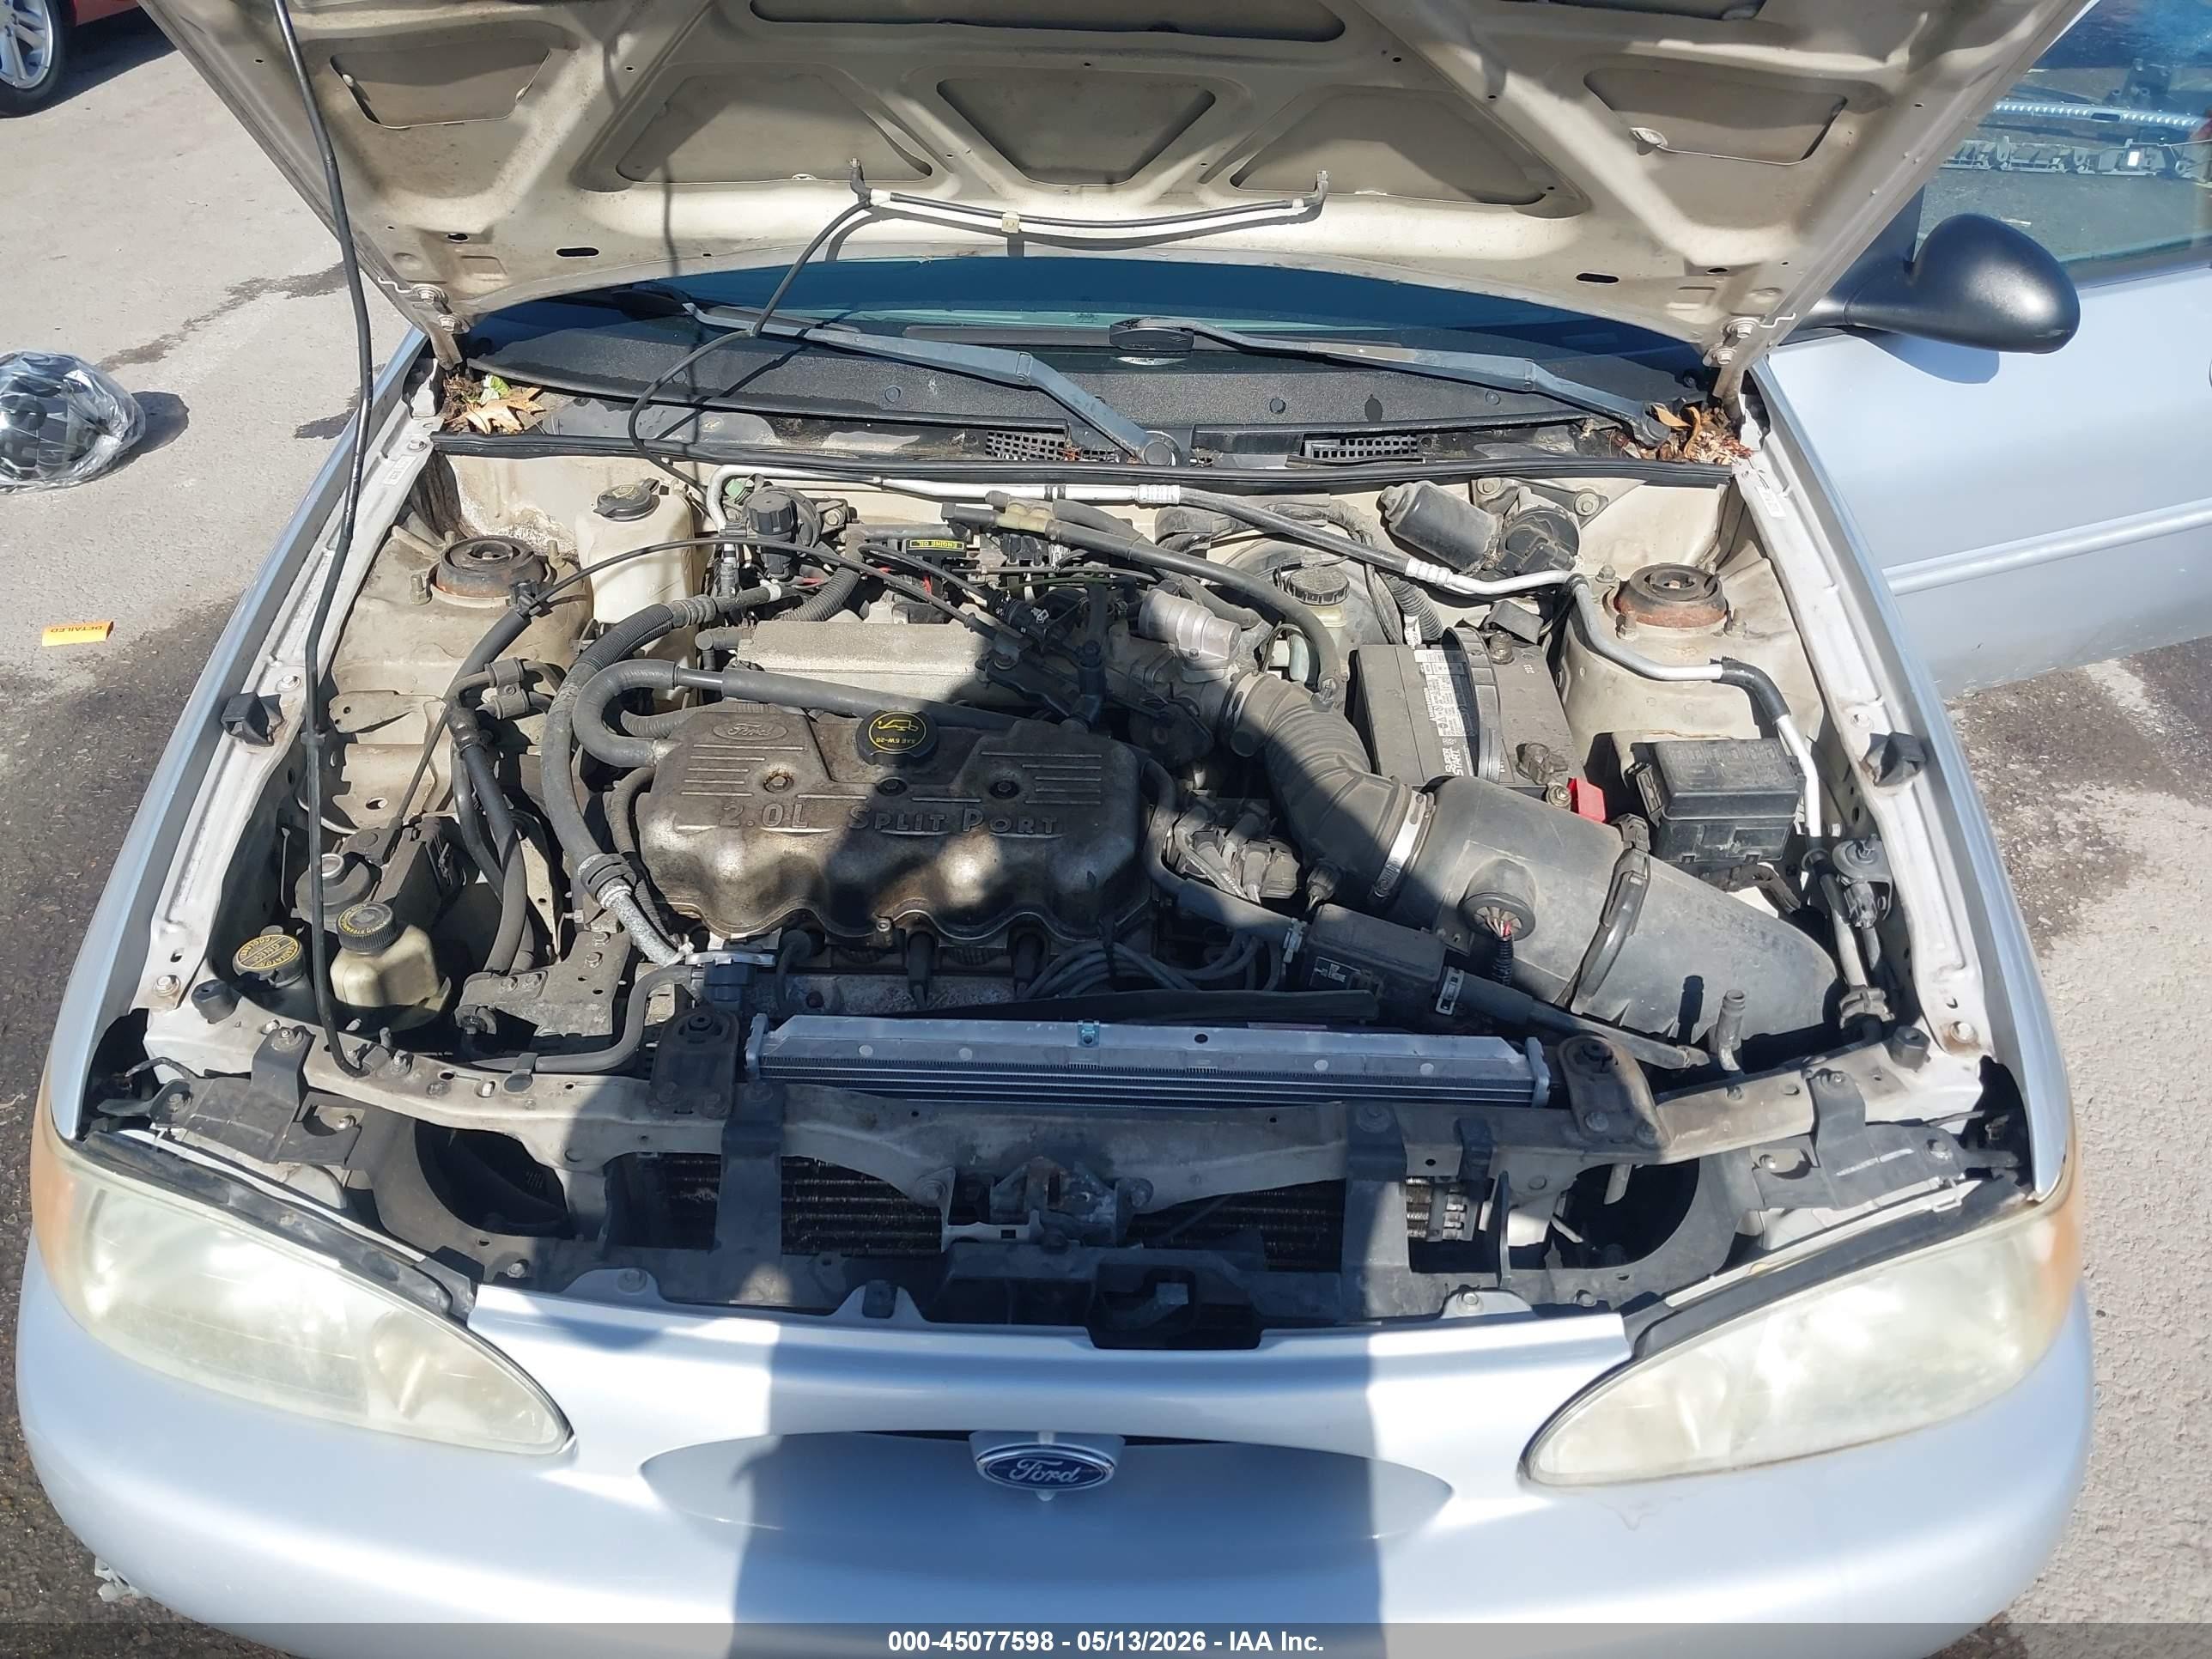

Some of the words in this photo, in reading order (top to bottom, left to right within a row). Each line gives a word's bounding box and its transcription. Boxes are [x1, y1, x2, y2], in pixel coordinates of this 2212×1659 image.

[727, 723, 774, 736] Ford
[1443, 747, 1453, 773] SUPER
[718, 803, 810, 829] 2.0L
[240, 937, 272, 956] COOLANT
[1009, 1459, 1081, 1483] Ford
